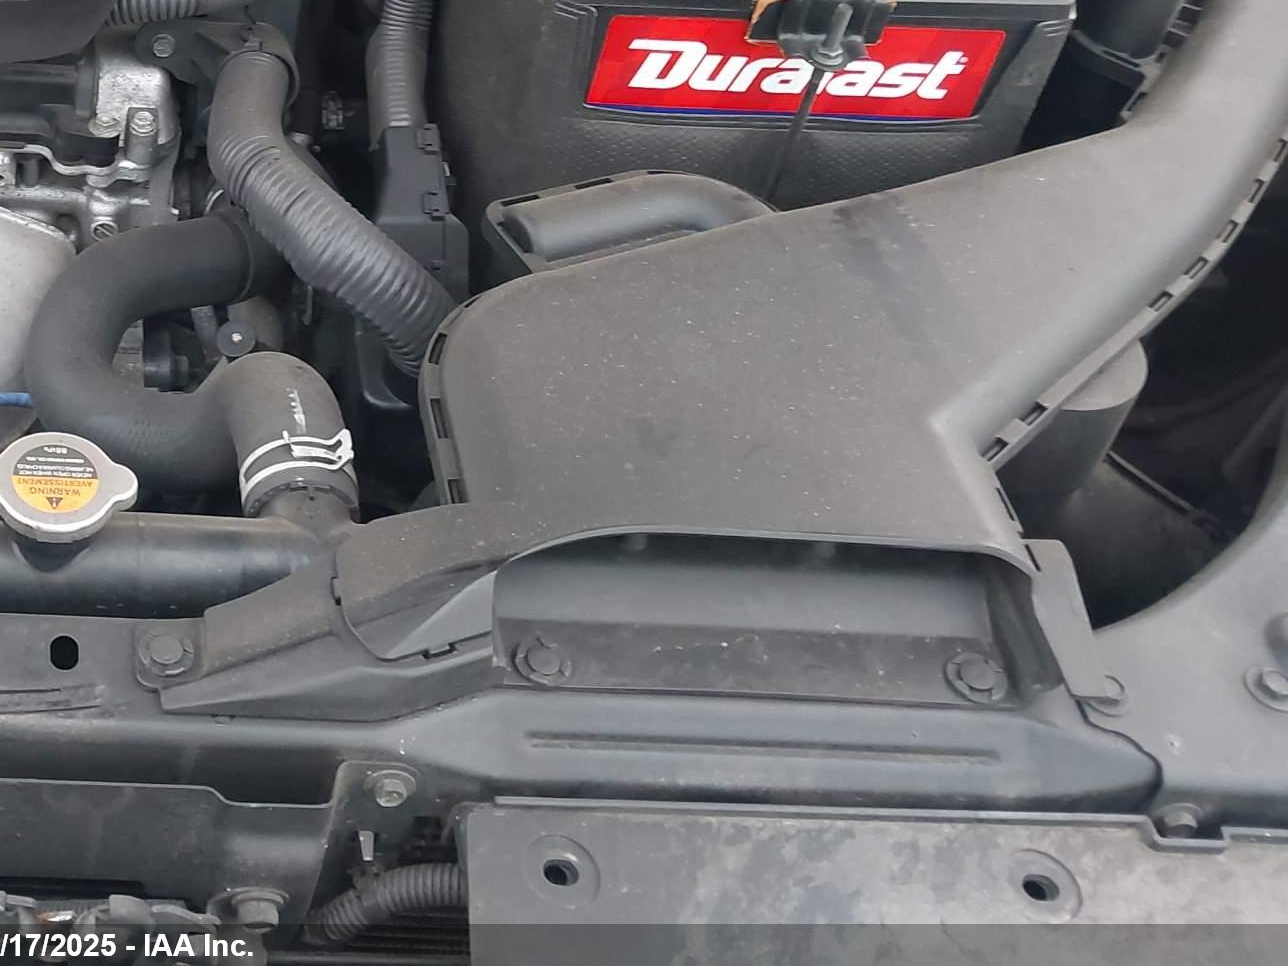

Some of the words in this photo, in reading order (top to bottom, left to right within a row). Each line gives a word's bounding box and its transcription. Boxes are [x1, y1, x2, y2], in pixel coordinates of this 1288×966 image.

[627, 38, 969, 99] Duraast
[17, 477, 93, 487] AVERTISSEMENT
[29, 487, 81, 496] WARNING
